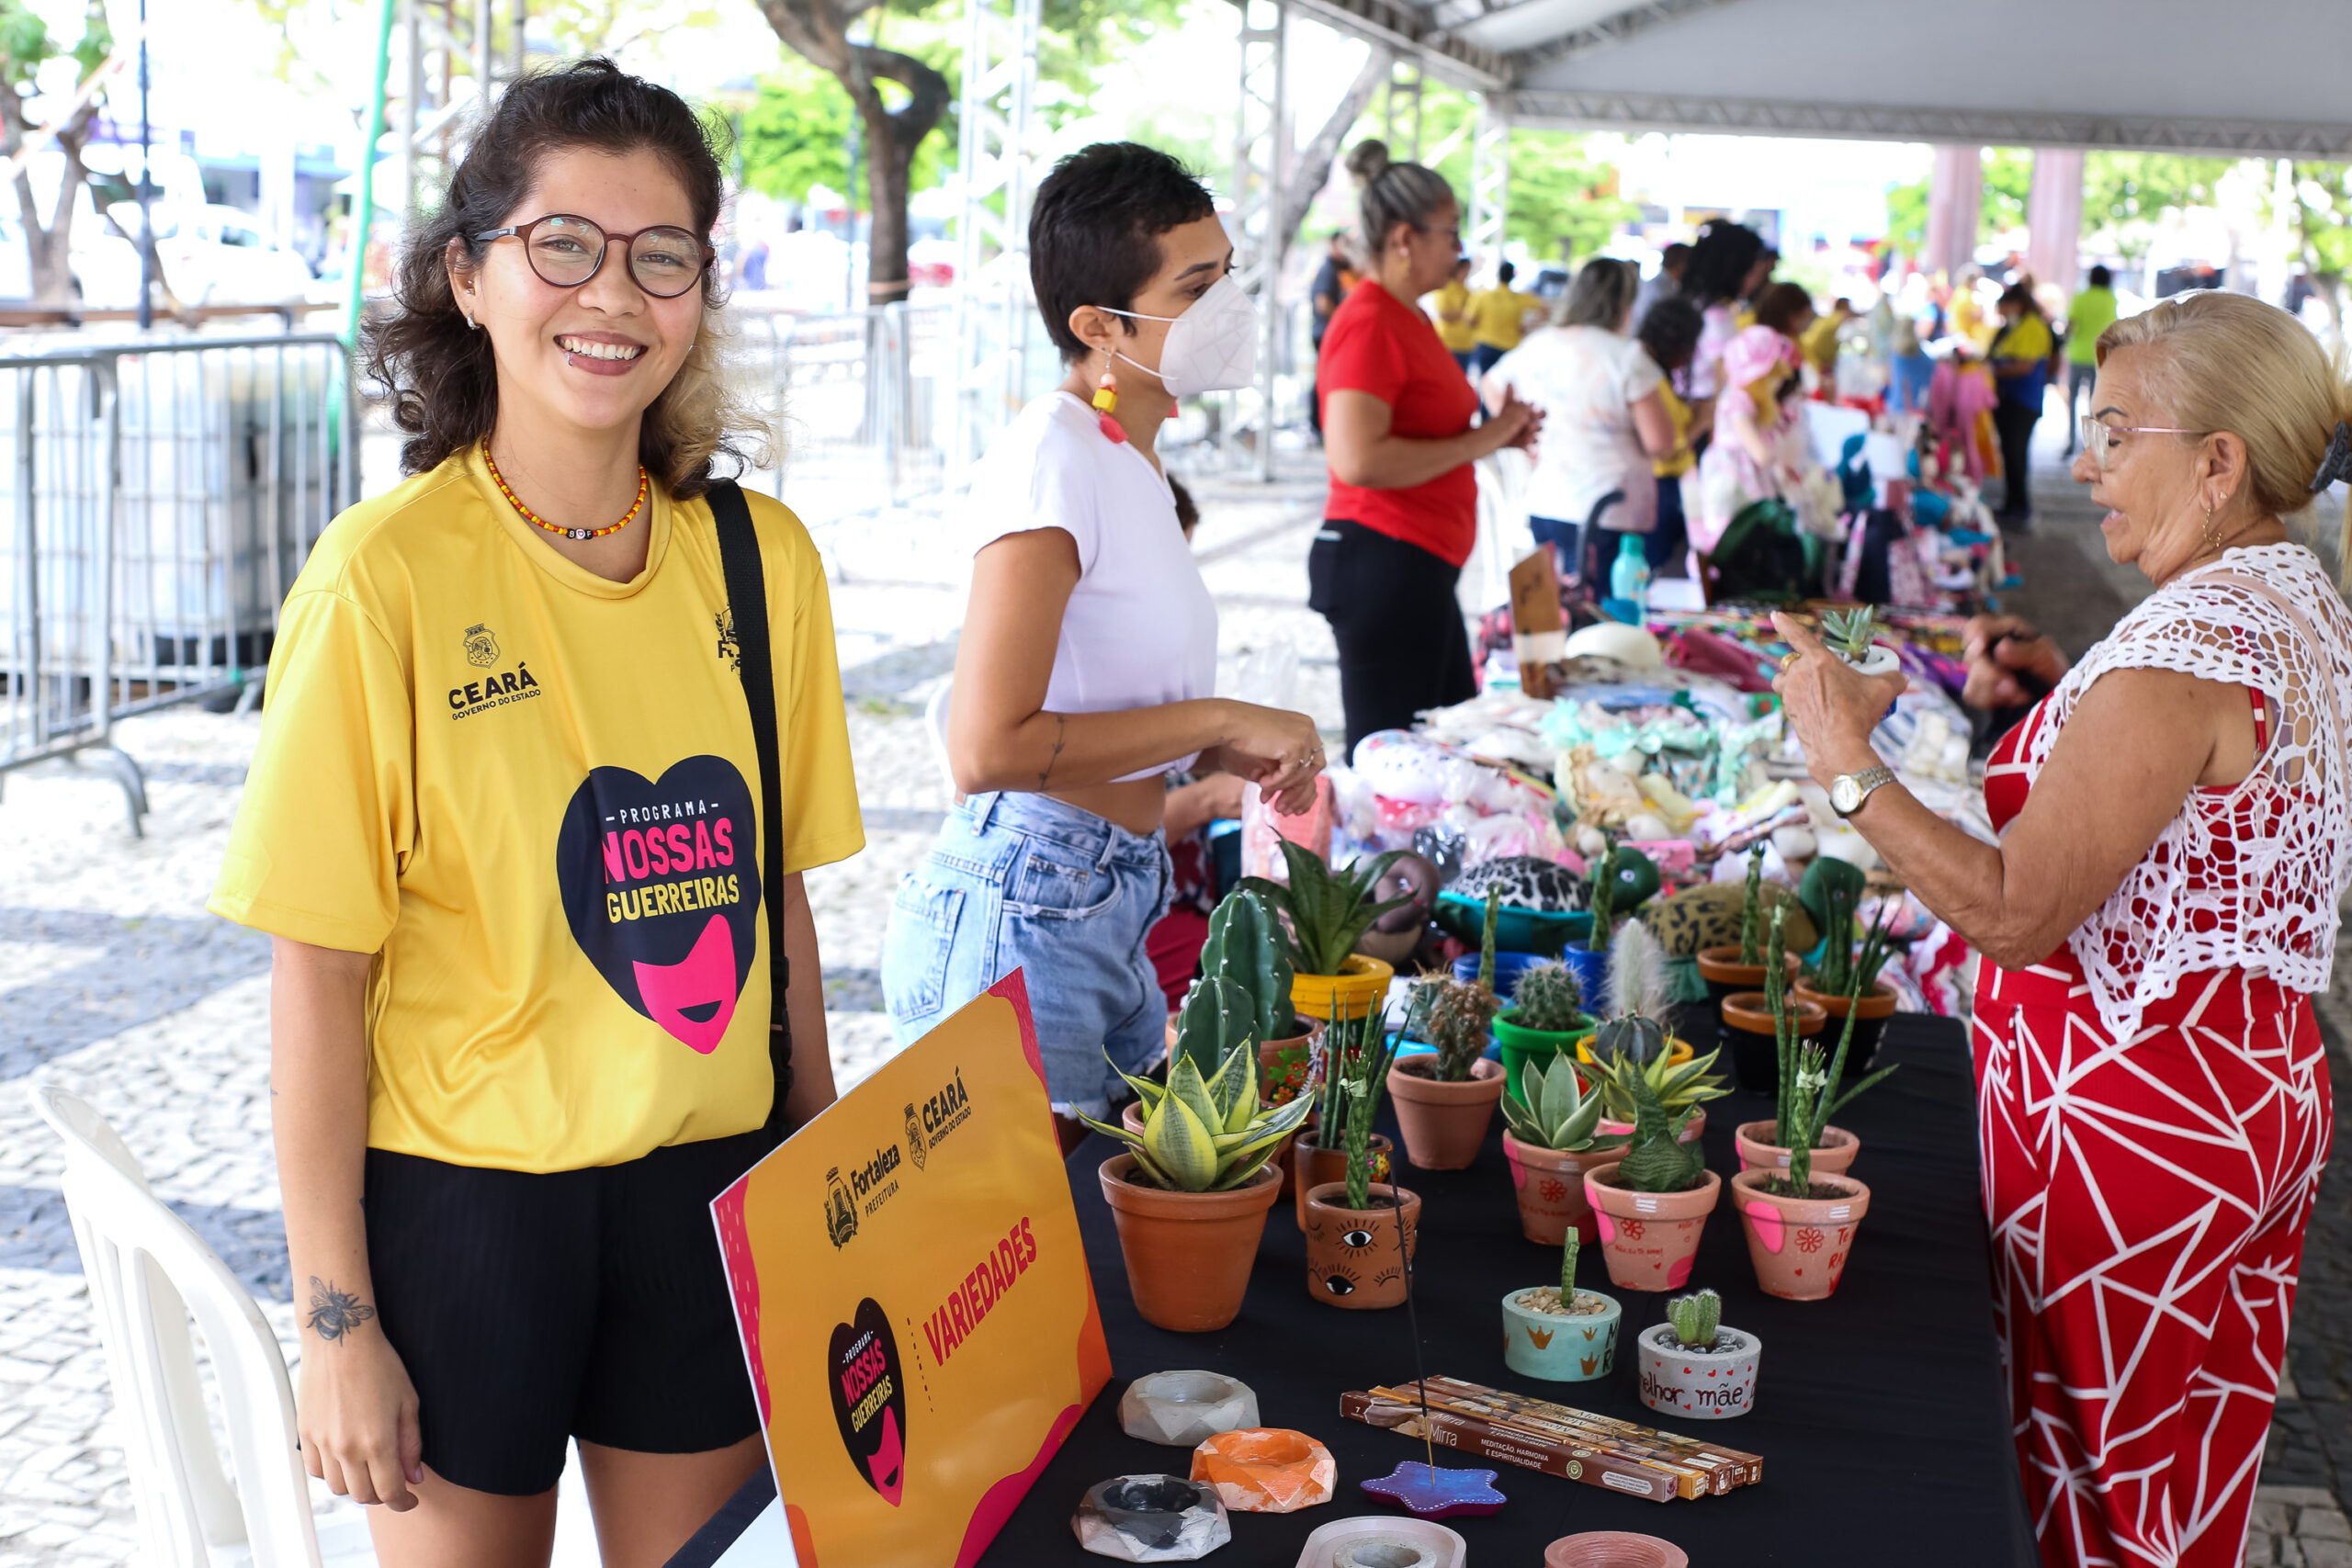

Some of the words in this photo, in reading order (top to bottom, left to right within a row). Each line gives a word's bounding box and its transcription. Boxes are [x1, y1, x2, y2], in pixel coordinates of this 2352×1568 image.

[448, 661, 538, 710] CEARÁ
[452, 700, 496, 721] GOVERNO
[497, 696, 510, 706] DO
[511, 689, 541, 703] ESTADO
[619, 799, 707, 824] PROGRAMA
[602, 818, 734, 885] NOSSAS
[606, 874, 741, 924] GUERREIRAS
[922, 1065, 969, 1134] CEARÁ
[928, 1125, 949, 1150] GOVERNO
[948, 1118, 956, 1133] DO
[956, 1106, 972, 1127] ESTADO
[850, 1144, 901, 1201] Fortaleza
[865, 1179, 900, 1218] PREFEITURA
[922, 1216, 1037, 1368] VARIEDADES
[841, 1338, 887, 1408] NOSSAS
[1695, 1382, 1743, 1406] mãe
[851, 1374, 893, 1434] GUERREIRAS
[1429, 1423, 1458, 1447] Mirra
[1480, 1438, 1515, 1453] MEDITAÇÃO,
[1516, 1448, 1549, 1461] HARMONIA
[1491, 1450, 1543, 1470] ESPIRITUALIDADE
